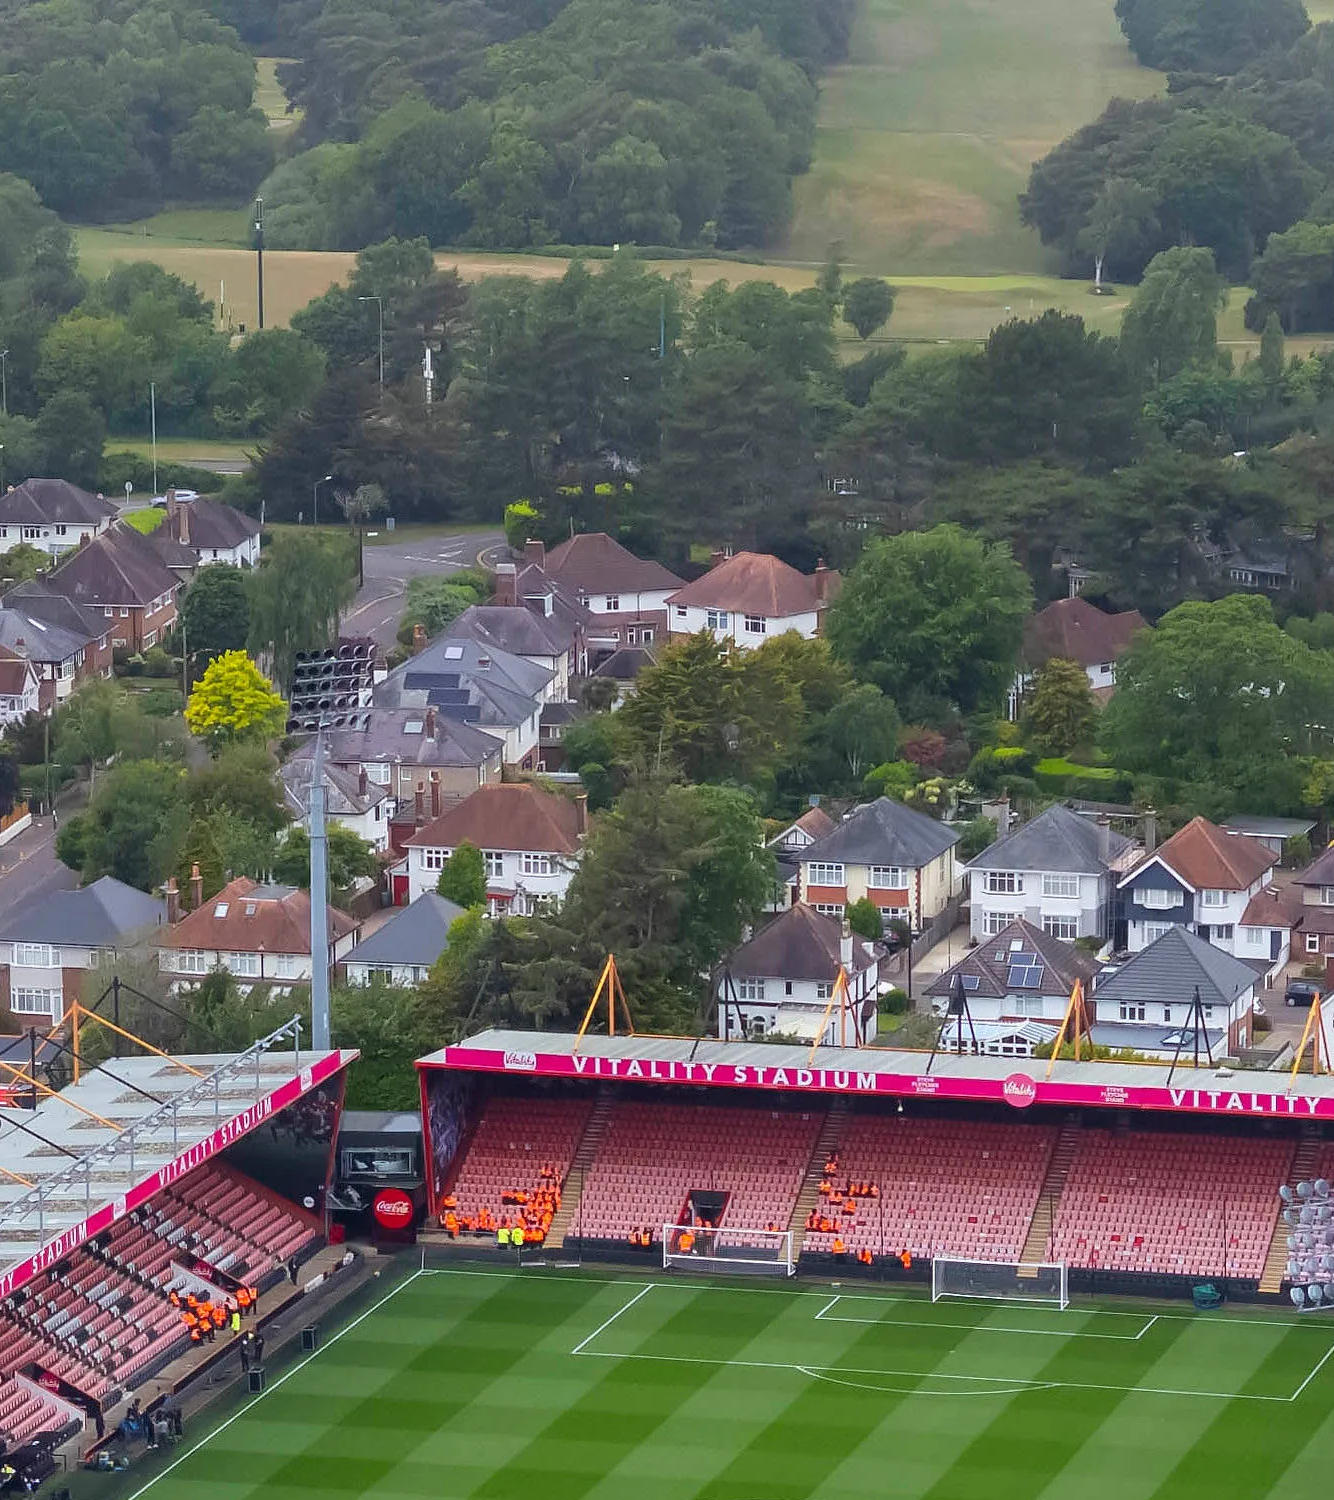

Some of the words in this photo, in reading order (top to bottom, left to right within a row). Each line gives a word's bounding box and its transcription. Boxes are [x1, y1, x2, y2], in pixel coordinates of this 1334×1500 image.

[572, 1056, 717, 1082] VITALITY
[734, 1066, 877, 1090] STADIUM
[1004, 1081, 1036, 1098] Vitality
[1170, 1089, 1319, 1115] VITALITY
[158, 1134, 216, 1186] VITALITY
[221, 1097, 273, 1143] STADIUM
[32, 1221, 87, 1274] STADIUM
